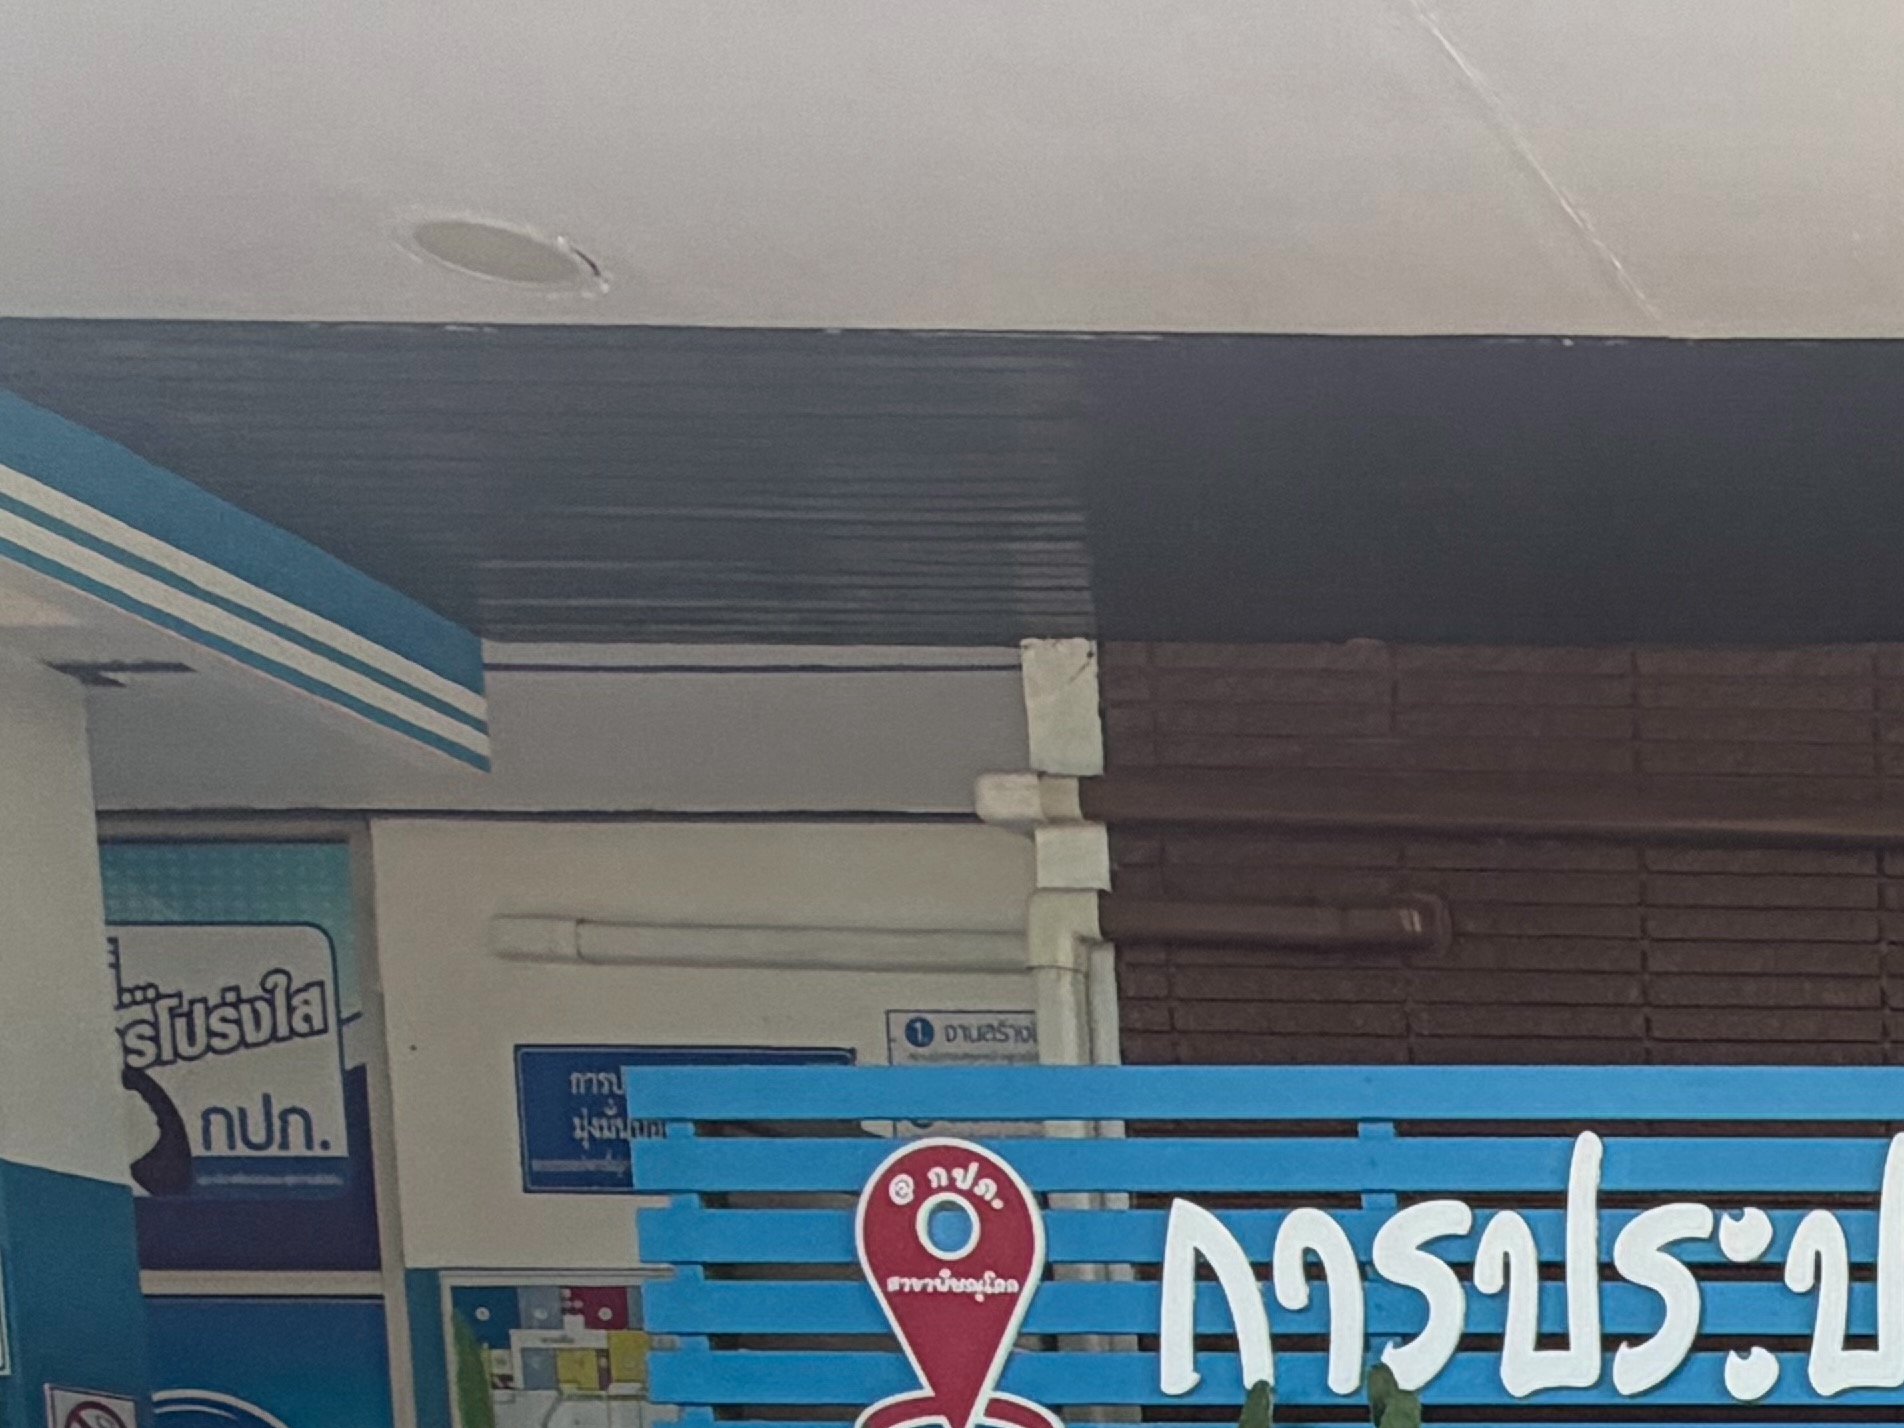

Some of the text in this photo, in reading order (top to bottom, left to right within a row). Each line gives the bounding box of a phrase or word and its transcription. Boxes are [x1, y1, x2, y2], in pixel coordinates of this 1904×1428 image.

[120, 967, 330, 1070] รโปร่งใส
[200, 1091, 332, 1152] กปภ.
[928, 1162, 1005, 1210] กปภ.
